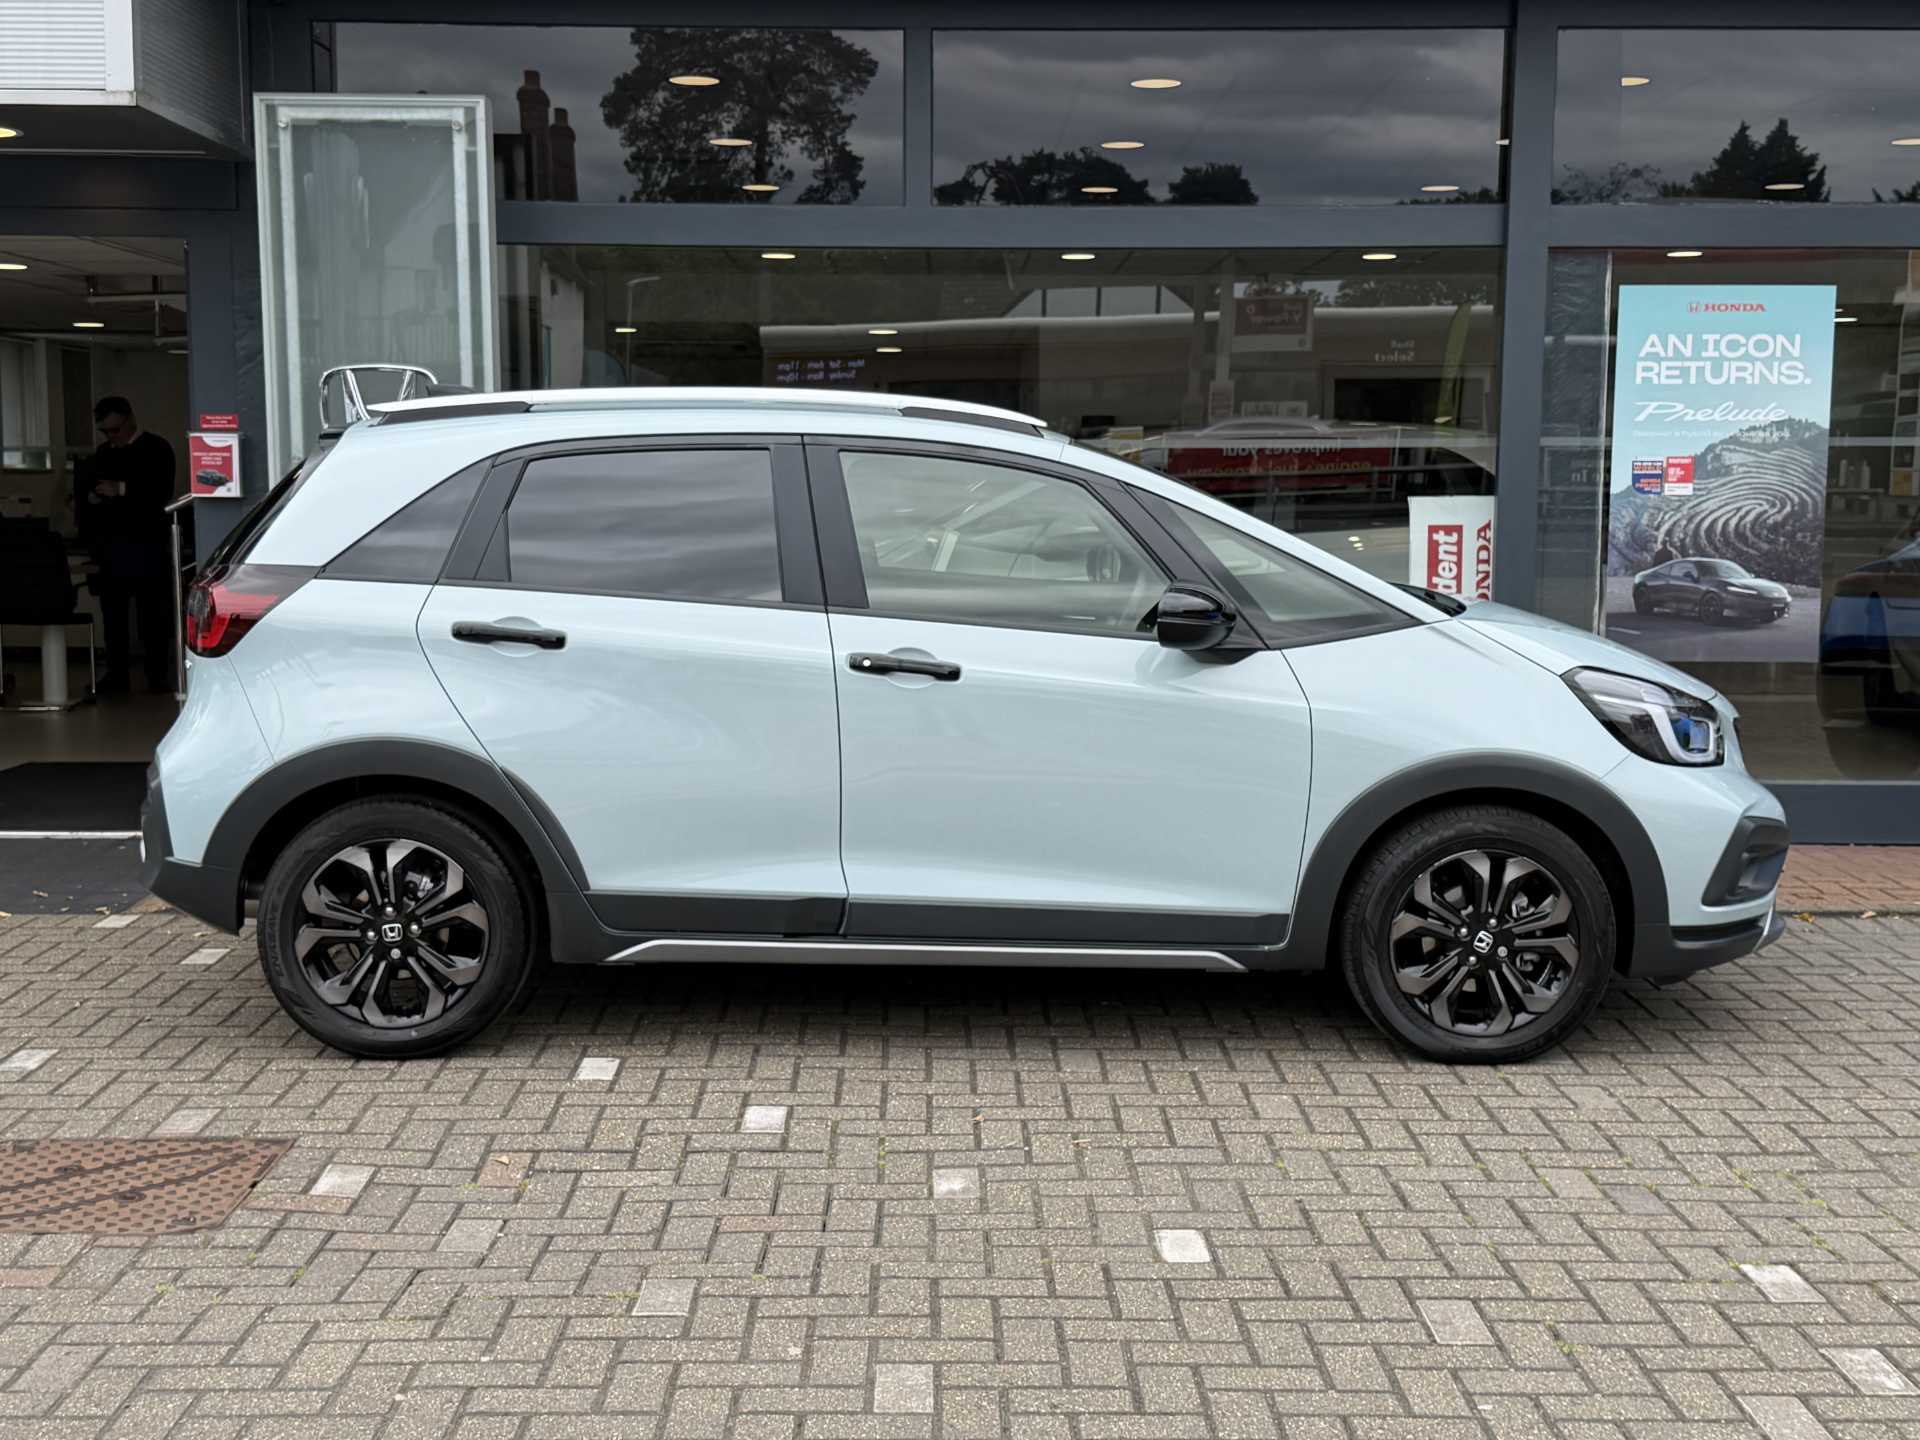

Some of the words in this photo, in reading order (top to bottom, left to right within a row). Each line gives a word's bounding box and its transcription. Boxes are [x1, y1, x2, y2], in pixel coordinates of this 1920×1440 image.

[1703, 303, 1767, 313] HONDA
[1638, 334, 1693, 358] AN
[1701, 334, 1801, 358] ICON
[1635, 361, 1812, 385] RETURNS.
[1633, 402, 1789, 422] Prelude
